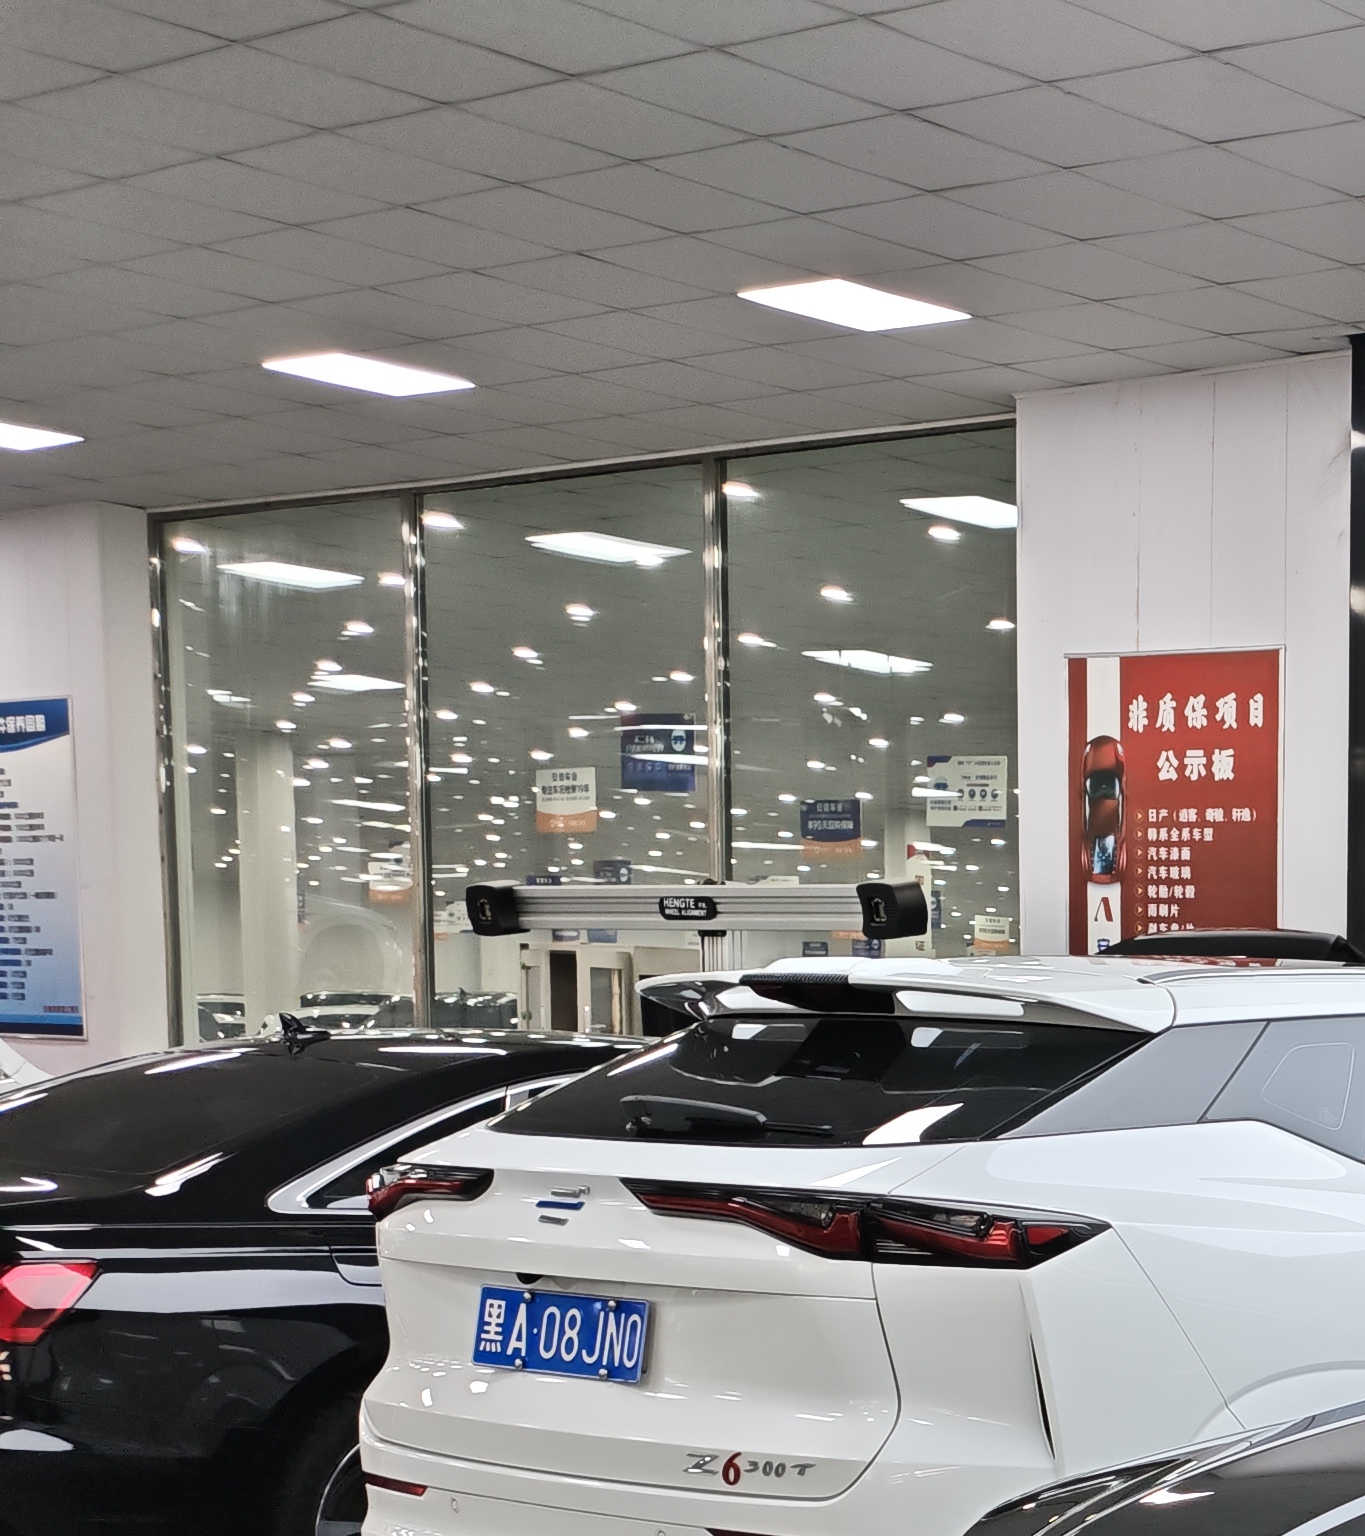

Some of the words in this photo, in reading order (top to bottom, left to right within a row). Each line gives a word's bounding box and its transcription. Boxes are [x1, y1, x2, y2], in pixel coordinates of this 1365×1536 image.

[1128, 692, 1264, 733] 非质保项目
[1157, 749, 1235, 781] 公示板
[1147, 846, 1191, 860] 汽车漆面
[1147, 866, 1191, 880] 汽车玻璃
[663, 897, 695, 909] HENGTE
[479, 1298, 642, 1368] 黑A·08JN0
